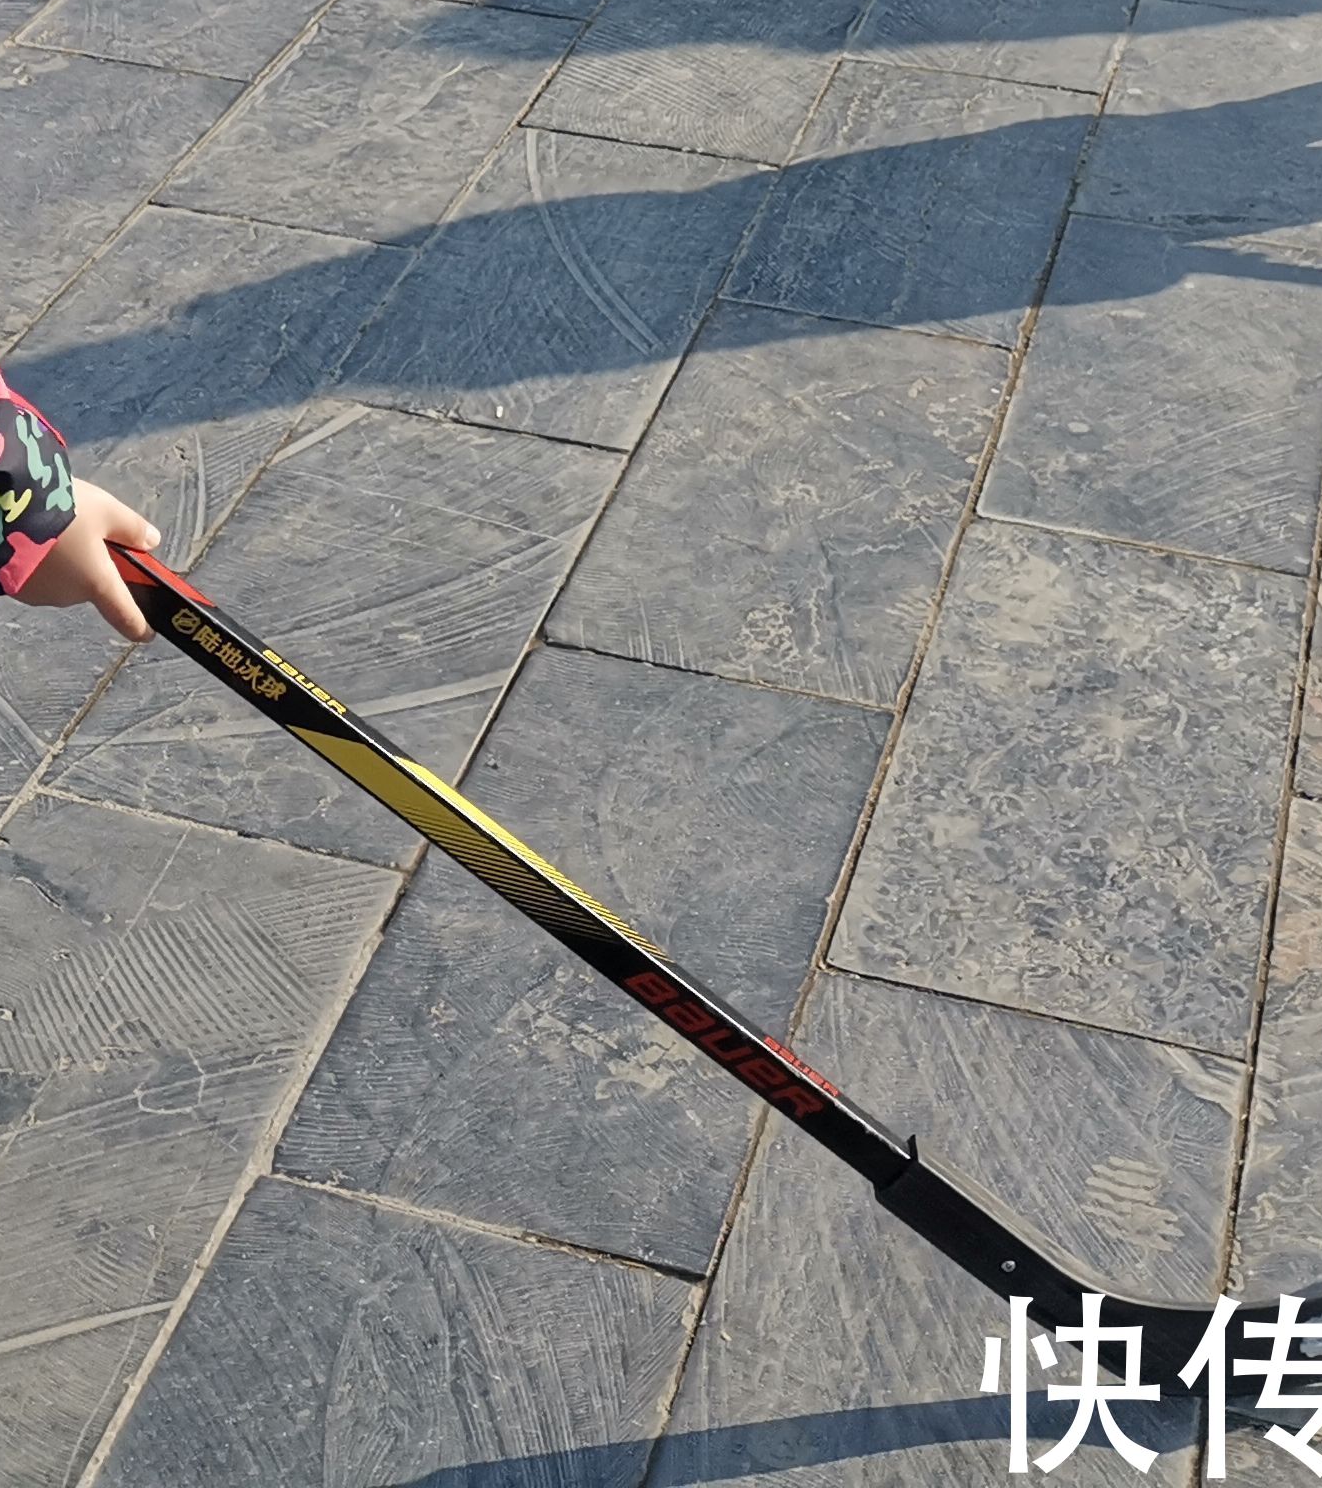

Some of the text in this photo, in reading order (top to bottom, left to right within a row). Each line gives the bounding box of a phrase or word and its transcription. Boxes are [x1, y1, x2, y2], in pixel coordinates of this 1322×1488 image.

[193, 625, 287, 702] 陆地冰球
[262, 648, 347, 716] BAUER
[625, 972, 824, 1119] BAUER
